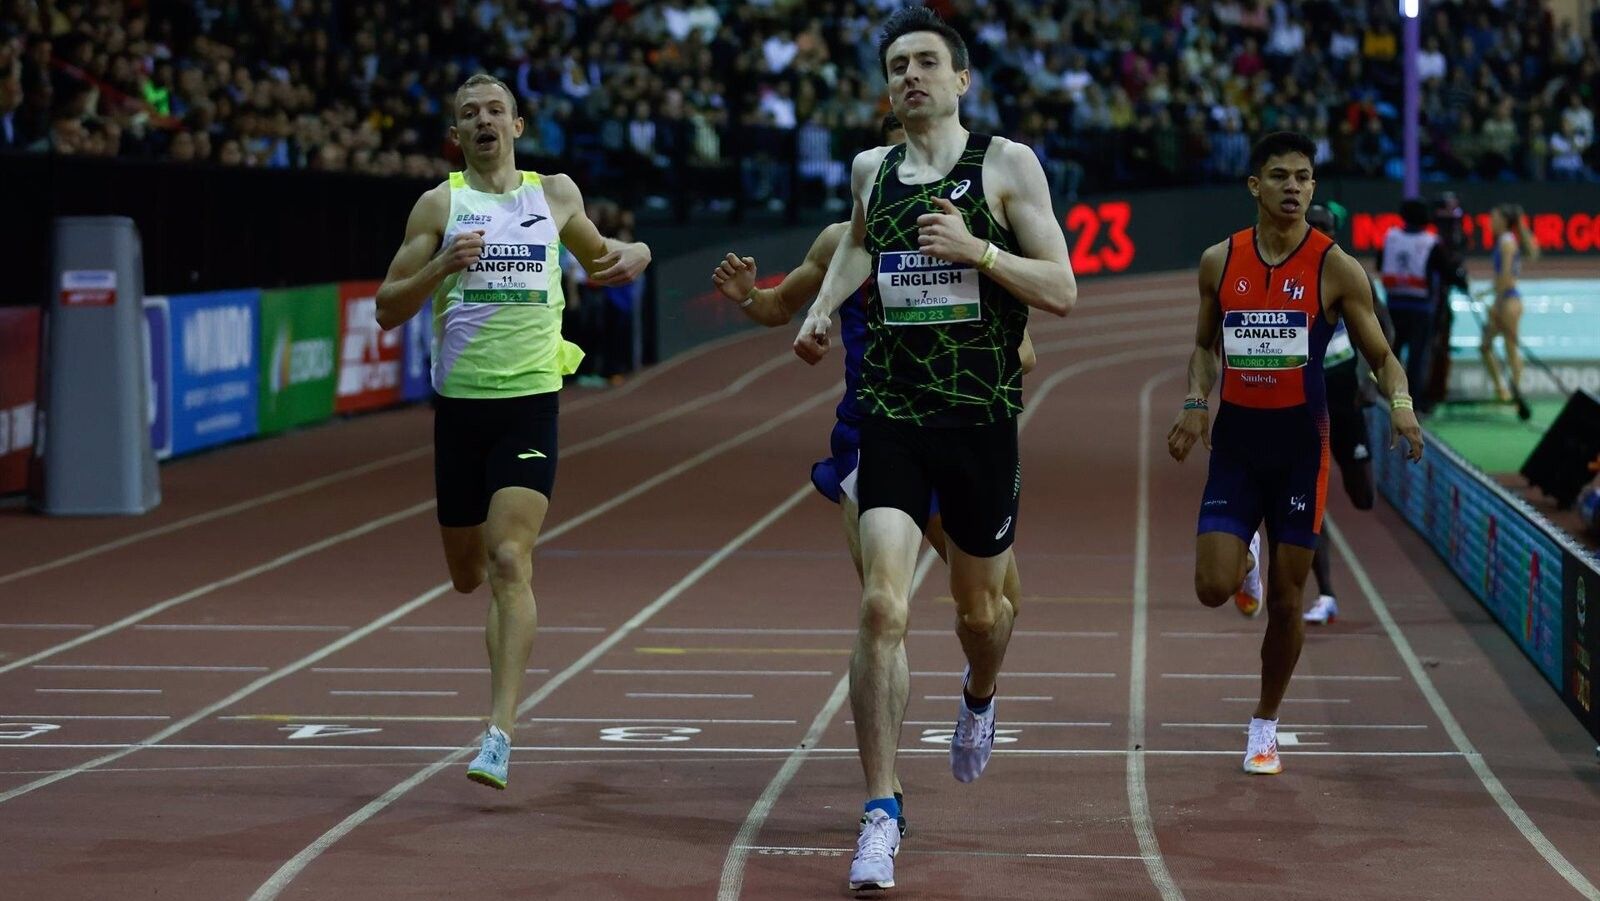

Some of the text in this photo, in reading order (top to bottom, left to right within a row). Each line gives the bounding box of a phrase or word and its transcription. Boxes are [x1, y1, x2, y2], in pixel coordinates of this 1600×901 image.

[456, 214, 492, 222] BEASTS
[1066, 202, 1135, 274] 23
[467, 262, 543, 273] LANGFORD
[496, 281, 527, 289] MADRID
[891, 272, 962, 287] ENGLISH
[1237, 280, 1247, 292] S
[470, 292, 522, 302] MADRID 23
[921, 290, 928, 298] 7
[914, 296, 948, 306] MADRID
[890, 310, 944, 321] MADRID 23
[1234, 328, 1297, 339] CANALES
[1233, 358, 1280, 367] MADRID 23
[278, 724, 383, 739] 4
[600, 726, 702, 742] 3
